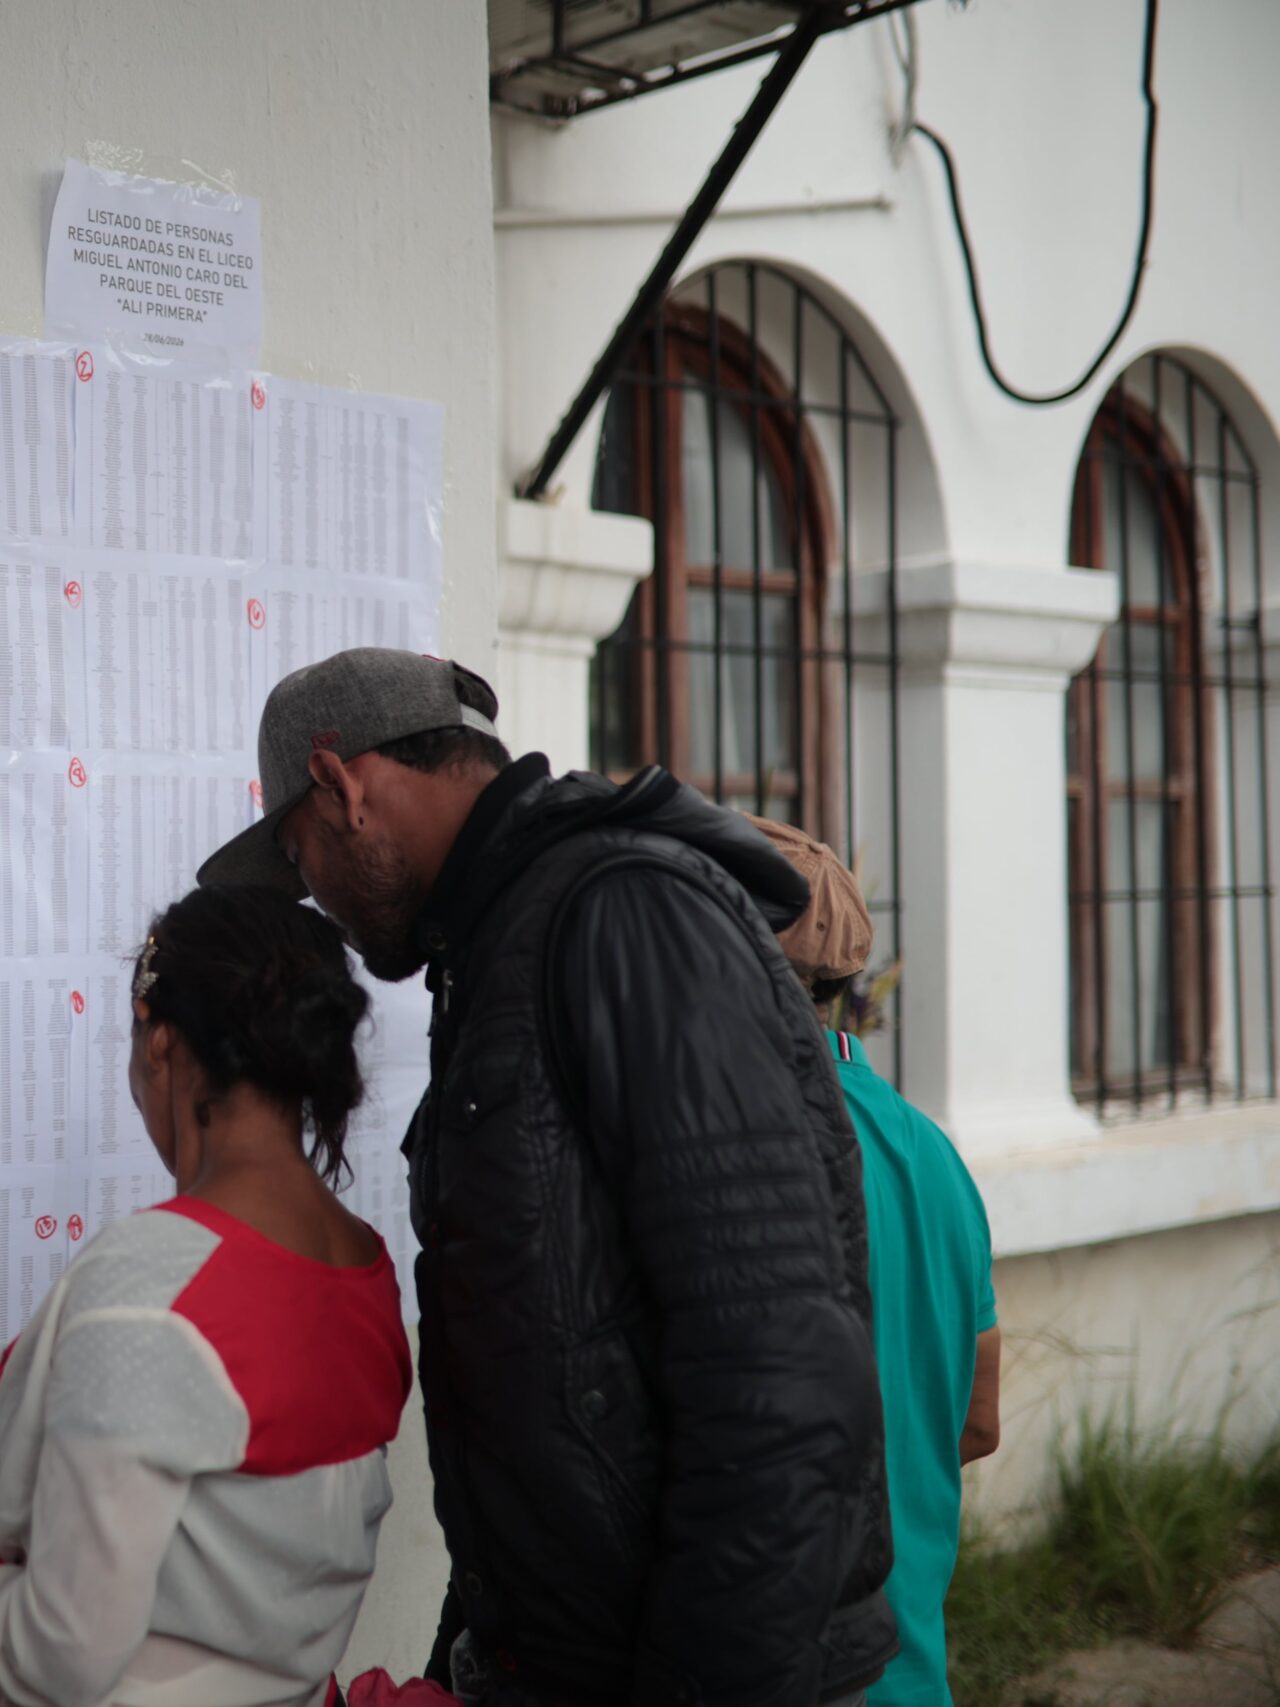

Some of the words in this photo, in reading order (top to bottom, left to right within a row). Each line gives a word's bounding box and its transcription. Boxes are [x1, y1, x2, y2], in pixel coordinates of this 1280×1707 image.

[88, 208, 141, 230] LISTADO
[145, 219, 162, 234] DE
[166, 222, 234, 247] PERSONAS
[68, 226, 174, 257] RESGUARDADAS
[178, 245, 195, 260] EN
[199, 248, 214, 264] EL
[217, 252, 254, 270] LICEO
[73, 248, 123, 270] MIGUEL
[127, 257, 182, 279] ANTONIO
[186, 267, 220, 285] CARO
[224, 273, 248, 289] DEL
[100, 273, 153, 295] PARQUE
[156, 282, 182, 300] DEL
[185, 287, 224, 306] OESTE
